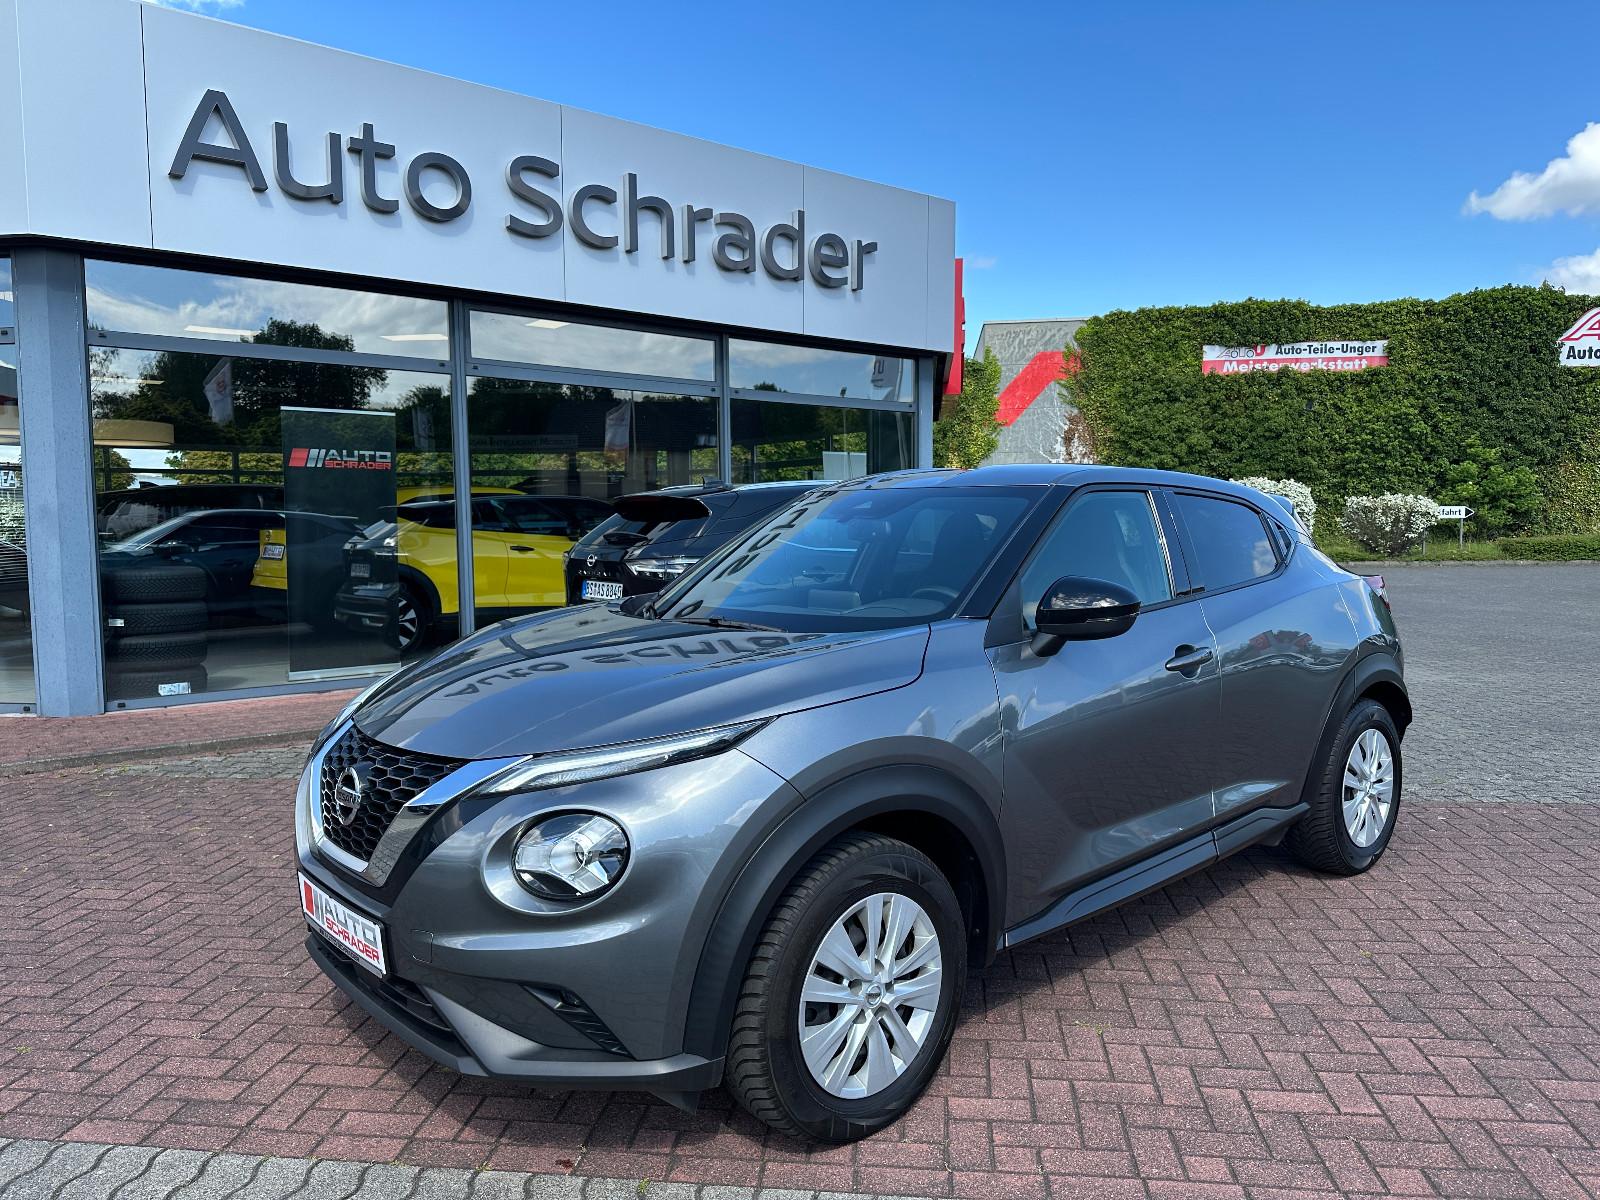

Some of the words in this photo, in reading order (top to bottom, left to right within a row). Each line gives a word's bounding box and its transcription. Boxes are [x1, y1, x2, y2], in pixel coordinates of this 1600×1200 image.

[168, 88, 472, 222] Auto
[505, 155, 878, 292] Schrader
[1275, 342, 1377, 356] Auto-Teile-Unger
[1223, 358, 1368, 373] Meistewerkstatt
[325, 449, 391, 462] AUTO
[324, 460, 392, 470] SCHRADER
[1439, 508, 1462, 516] fahrt
[325, 899, 379, 948] AUTO
[325, 915, 380, 962] SCHRADER
